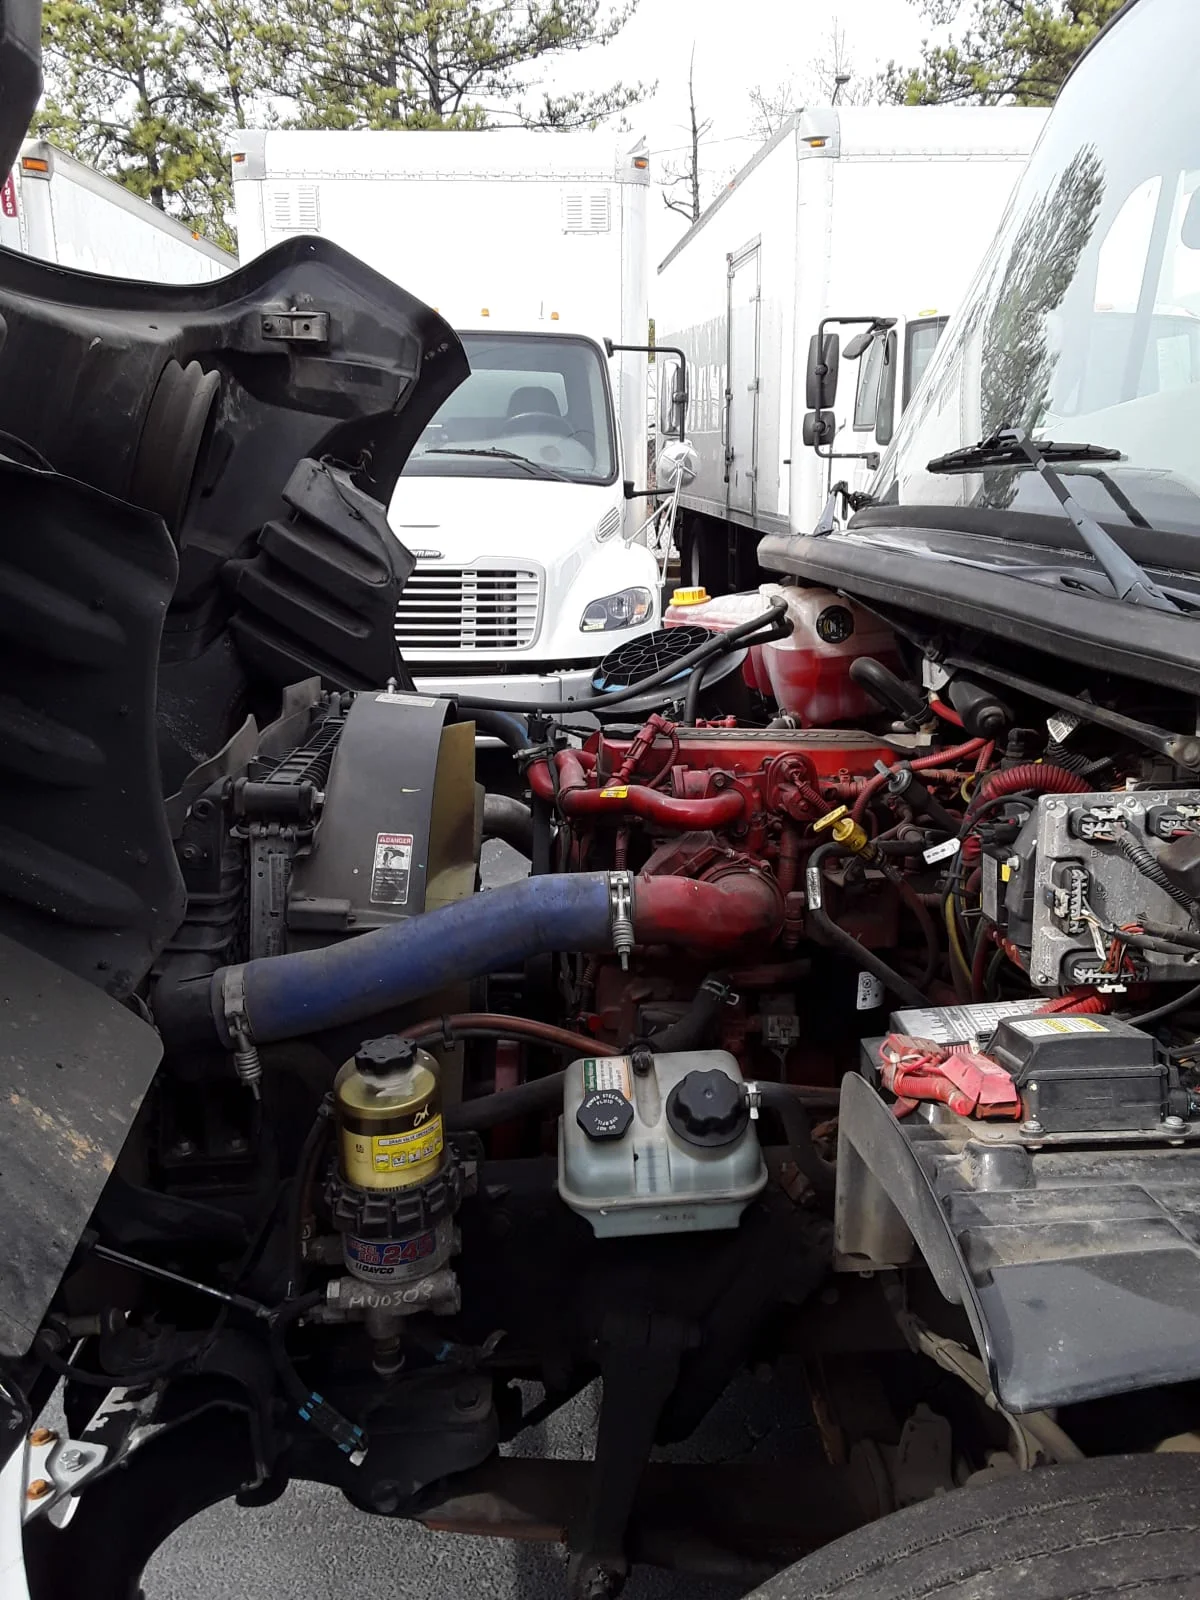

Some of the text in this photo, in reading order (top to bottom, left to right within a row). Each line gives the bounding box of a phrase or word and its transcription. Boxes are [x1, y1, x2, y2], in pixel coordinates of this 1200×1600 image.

[385, 837, 411, 845] DANGER
[586, 1093, 625, 1108] POWER STEERING
[381, 1234, 433, 1265] 245
